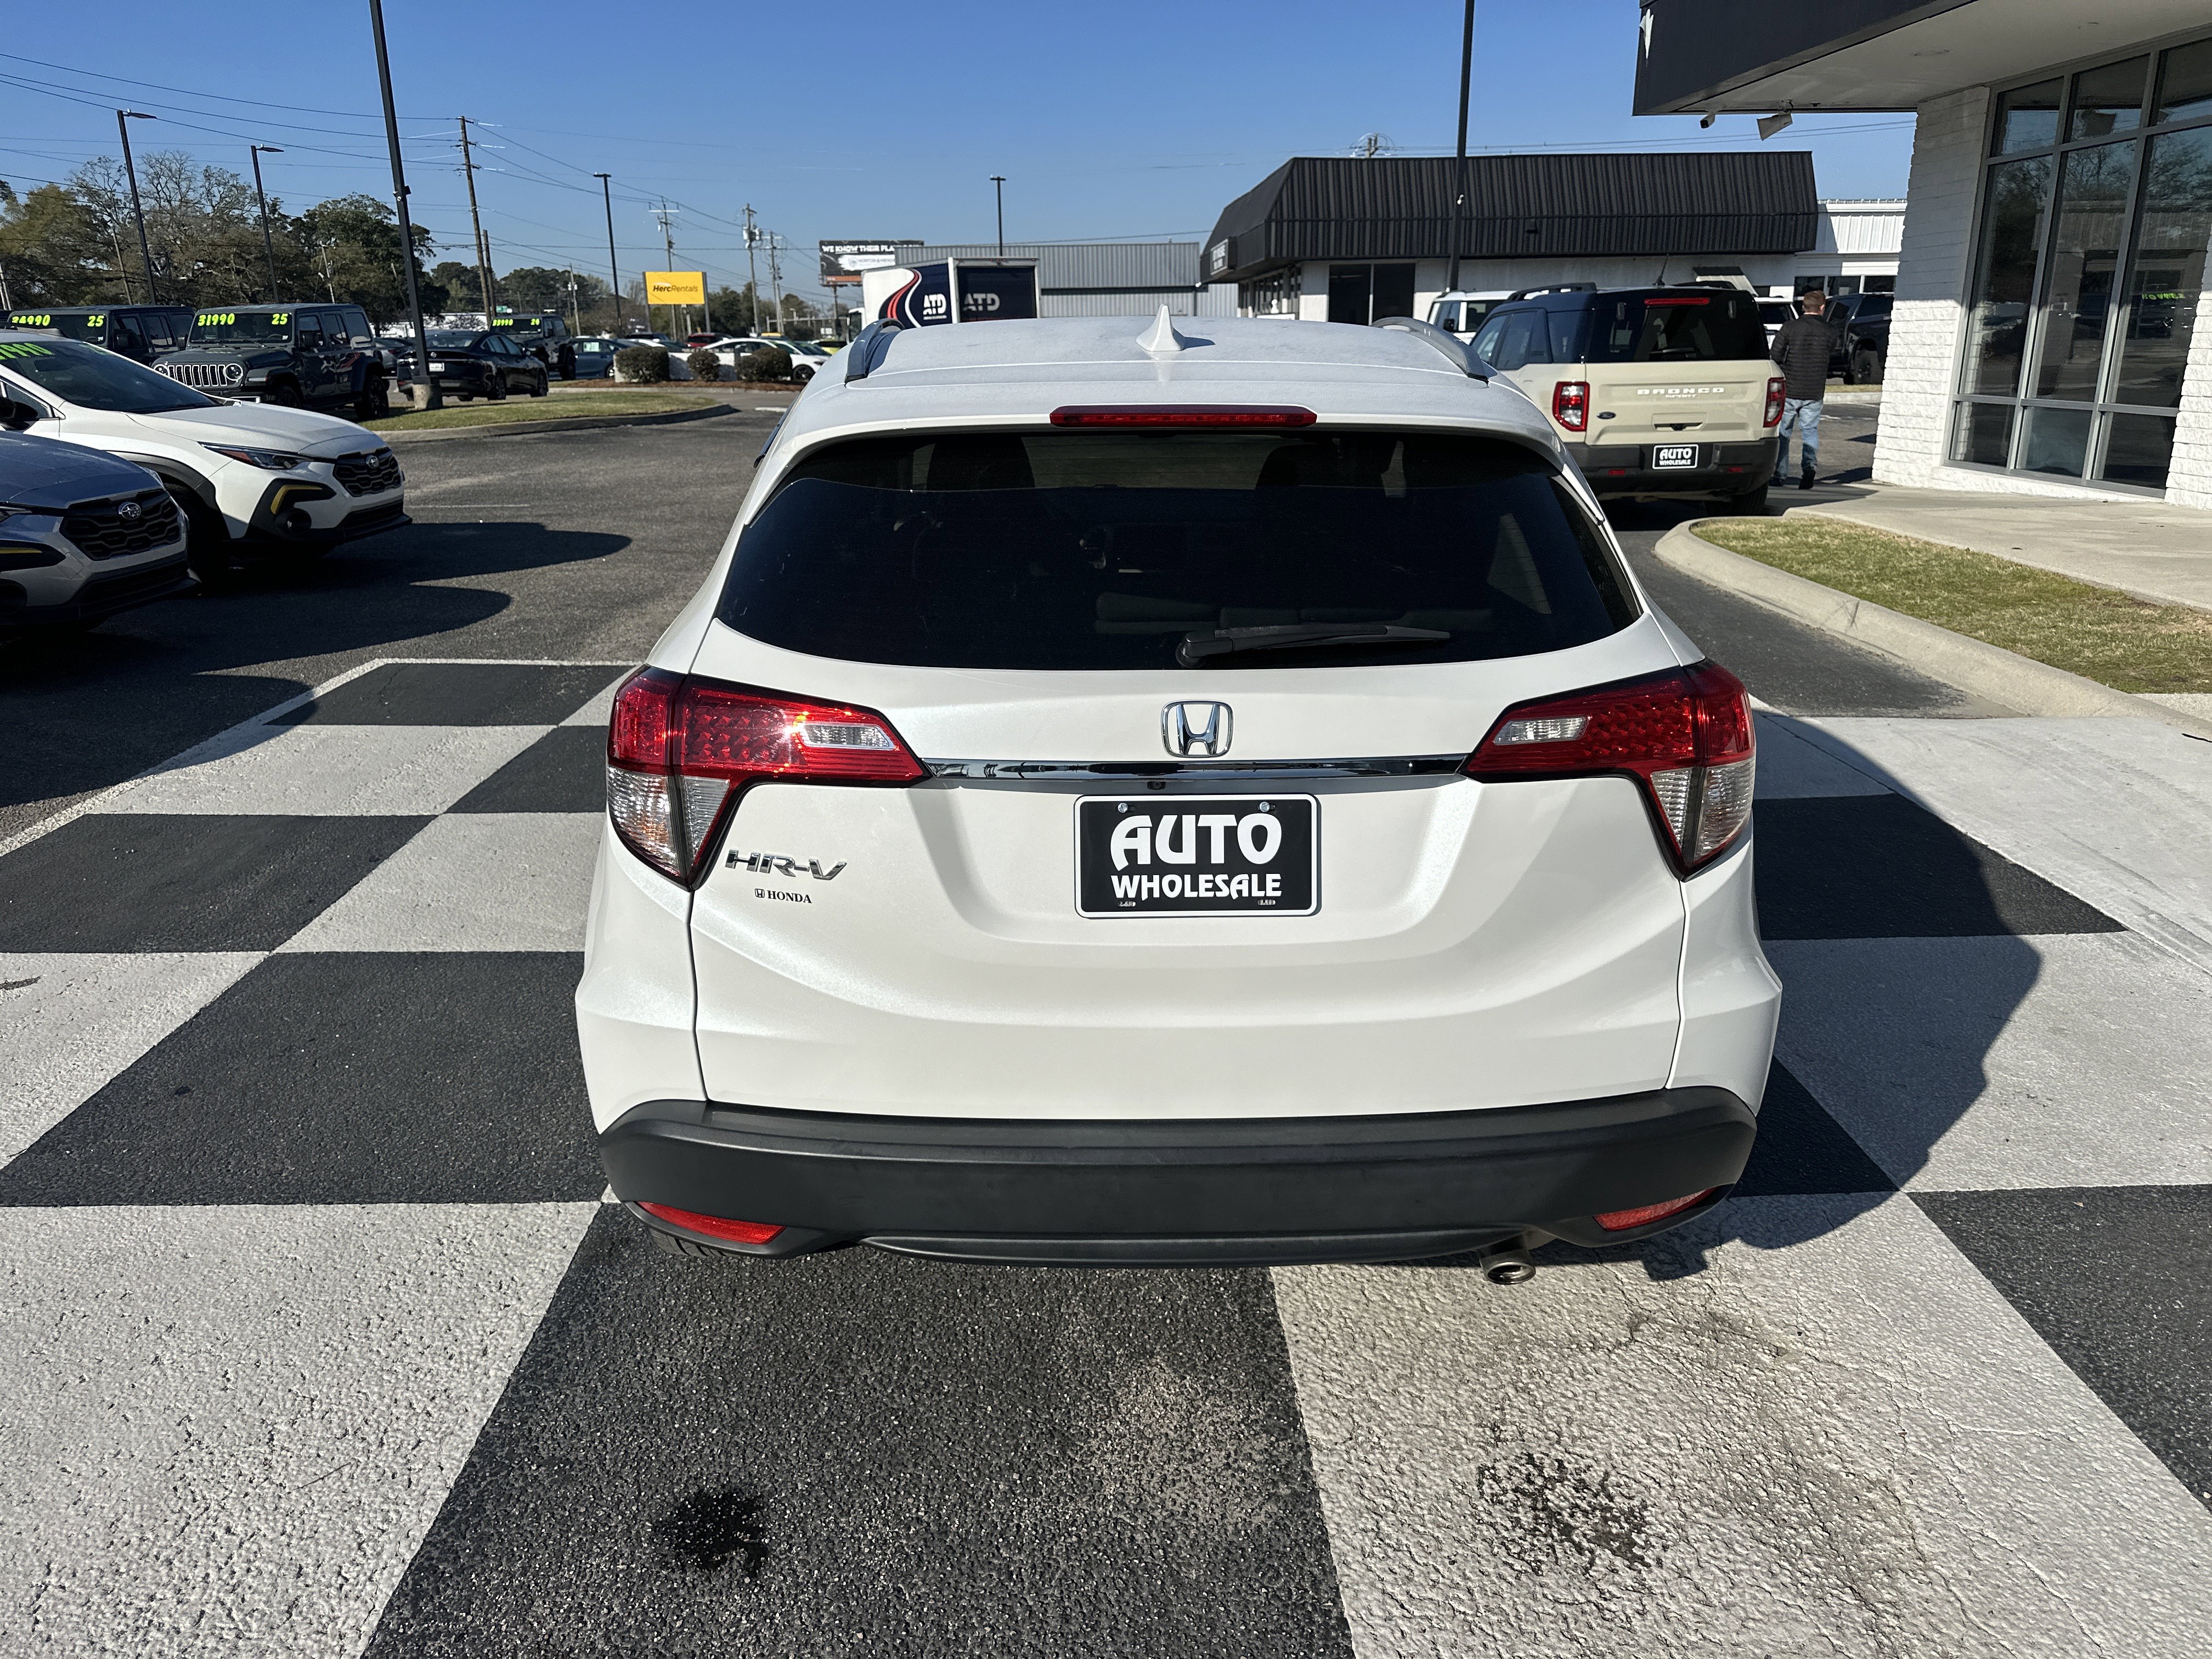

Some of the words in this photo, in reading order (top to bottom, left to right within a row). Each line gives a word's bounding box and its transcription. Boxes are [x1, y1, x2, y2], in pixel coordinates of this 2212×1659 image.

[923, 293, 947, 315] ATD
[962, 293, 1001, 312] ATD
[87, 315, 105, 327] 25
[198, 313, 235, 326] 31990
[272, 313, 288, 325] 25
[1659, 448, 1692, 460] AUTO
[1110, 812, 1282, 871] AUTO
[725, 849, 847, 881] HR-V
[1110, 873, 1282, 901] WHOLESALE
[767, 890, 812, 904] HONDA
